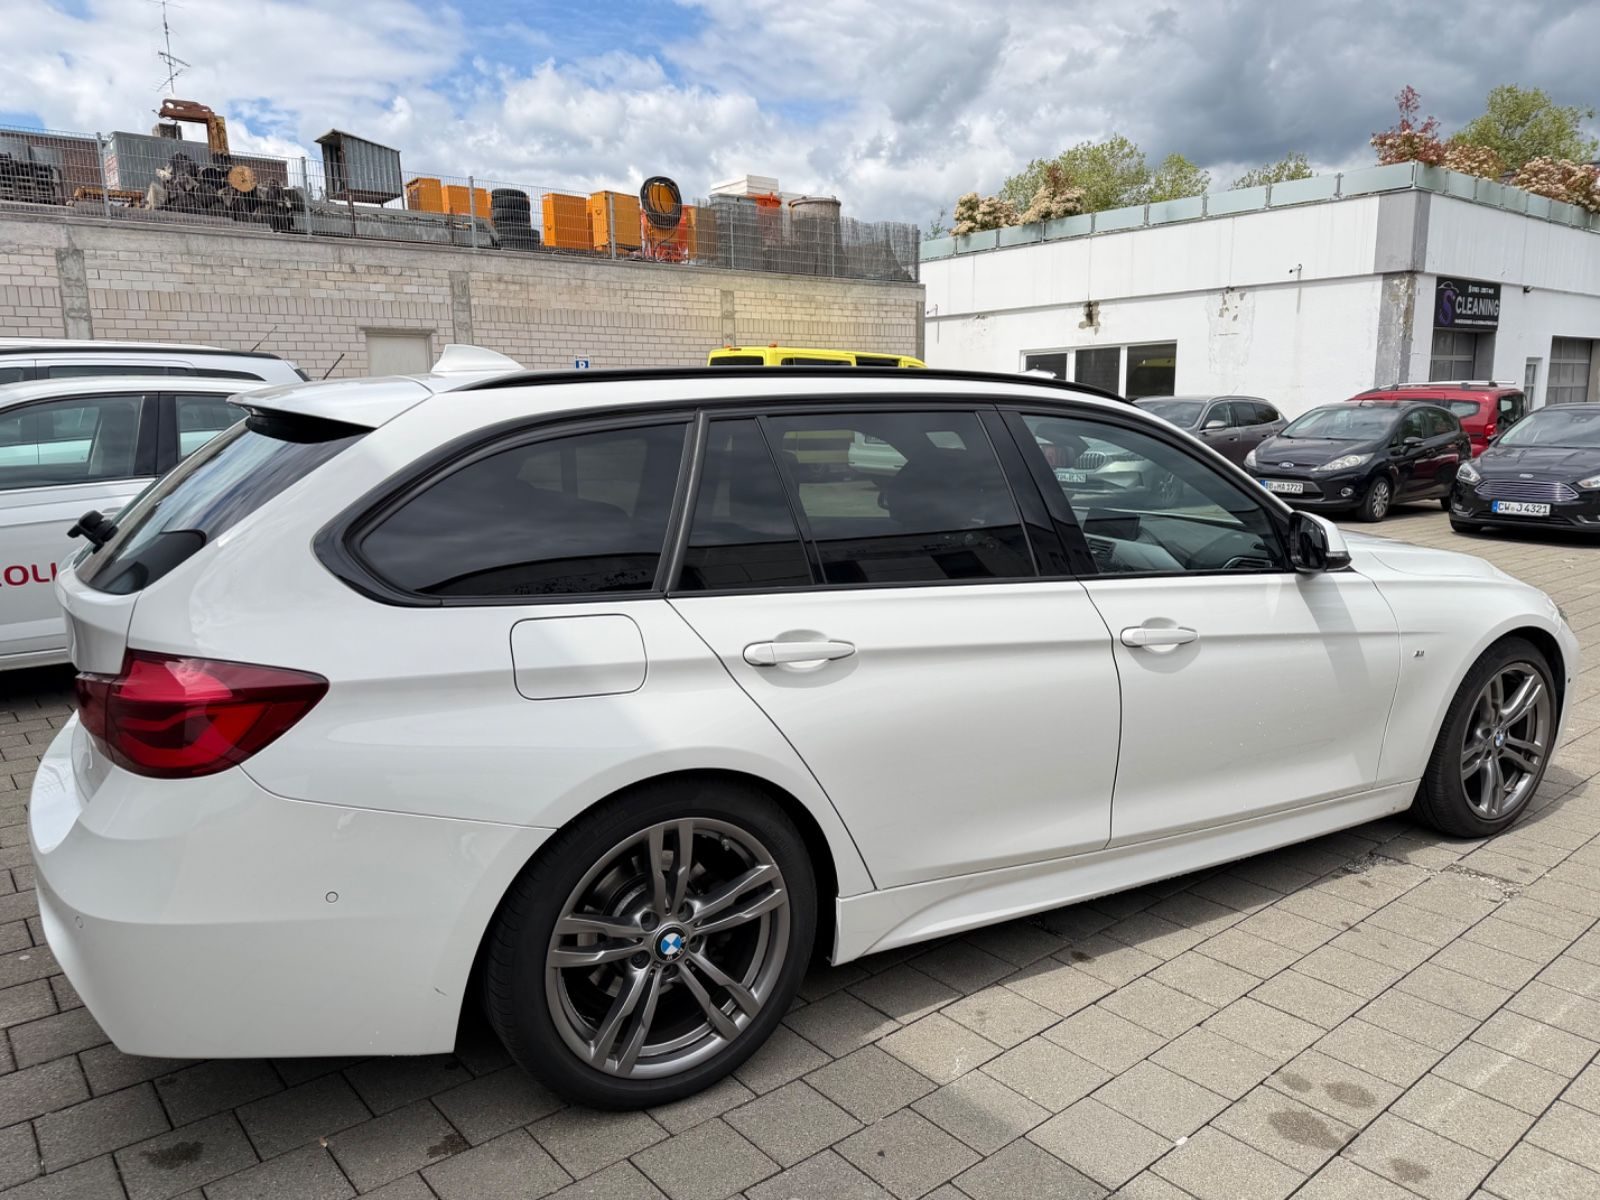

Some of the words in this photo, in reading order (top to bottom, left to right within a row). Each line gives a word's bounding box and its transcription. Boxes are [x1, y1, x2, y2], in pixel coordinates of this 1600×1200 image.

[1455, 295, 1500, 317] CLEANING
[1498, 502, 1511, 511] CW
[1516, 503, 1523, 512] J
[1524, 503, 1549, 514] 4321
